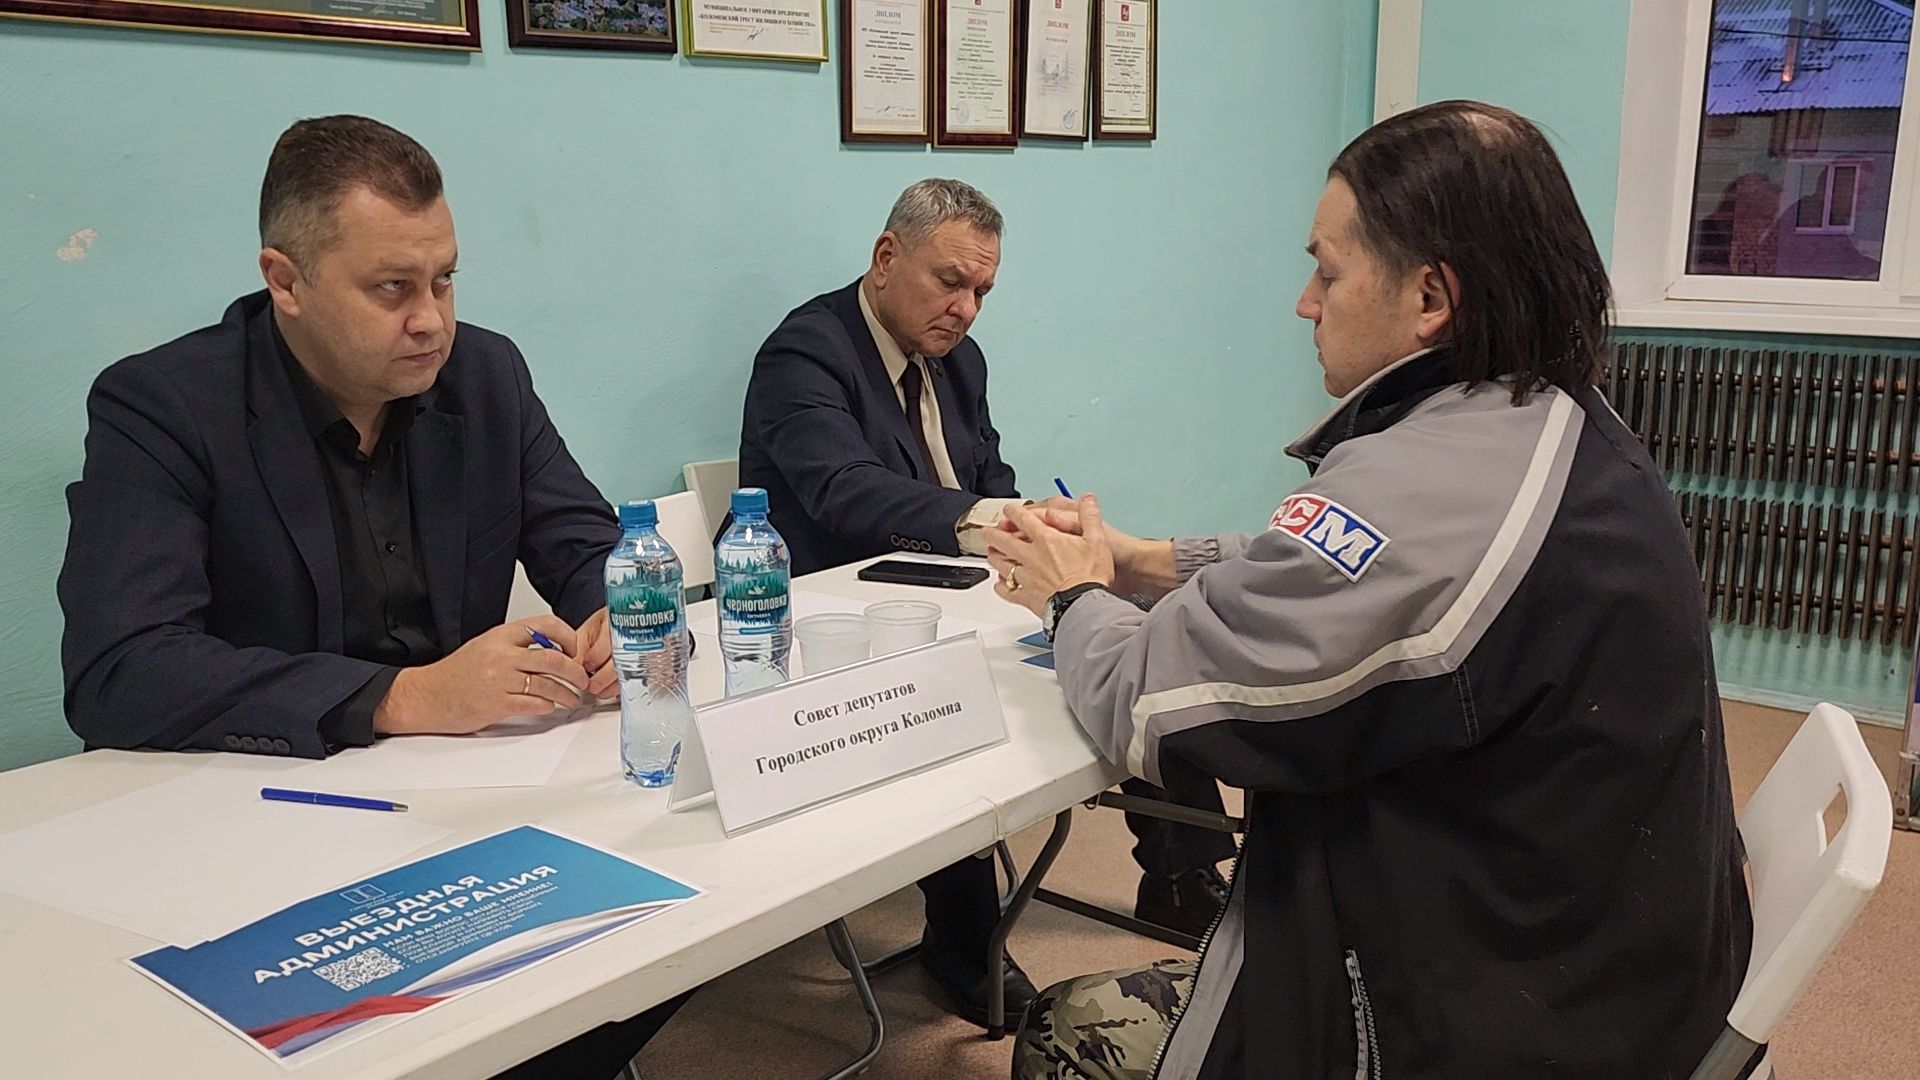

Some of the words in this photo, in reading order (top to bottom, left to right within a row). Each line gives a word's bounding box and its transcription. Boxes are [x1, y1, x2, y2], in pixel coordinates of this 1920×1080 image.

[874, 10, 901, 18] ДИПЛОМ
[756, 736, 846, 775] Городского
[849, 720, 899, 746] округа
[901, 699, 963, 730] Коломна
[794, 703, 840, 727] Совет
[843, 681, 917, 714] депутатов
[253, 865, 559, 984] АДМИНИСТРАЦИЯ
[294, 874, 485, 947] ВЫЕЗДНАЯ
[382, 933, 414, 948] НАМ
[413, 914, 463, 936] ВАЖНО
[462, 900, 500, 917] ВАШЕ
[499, 880, 553, 903] МНЕНИЕ!
